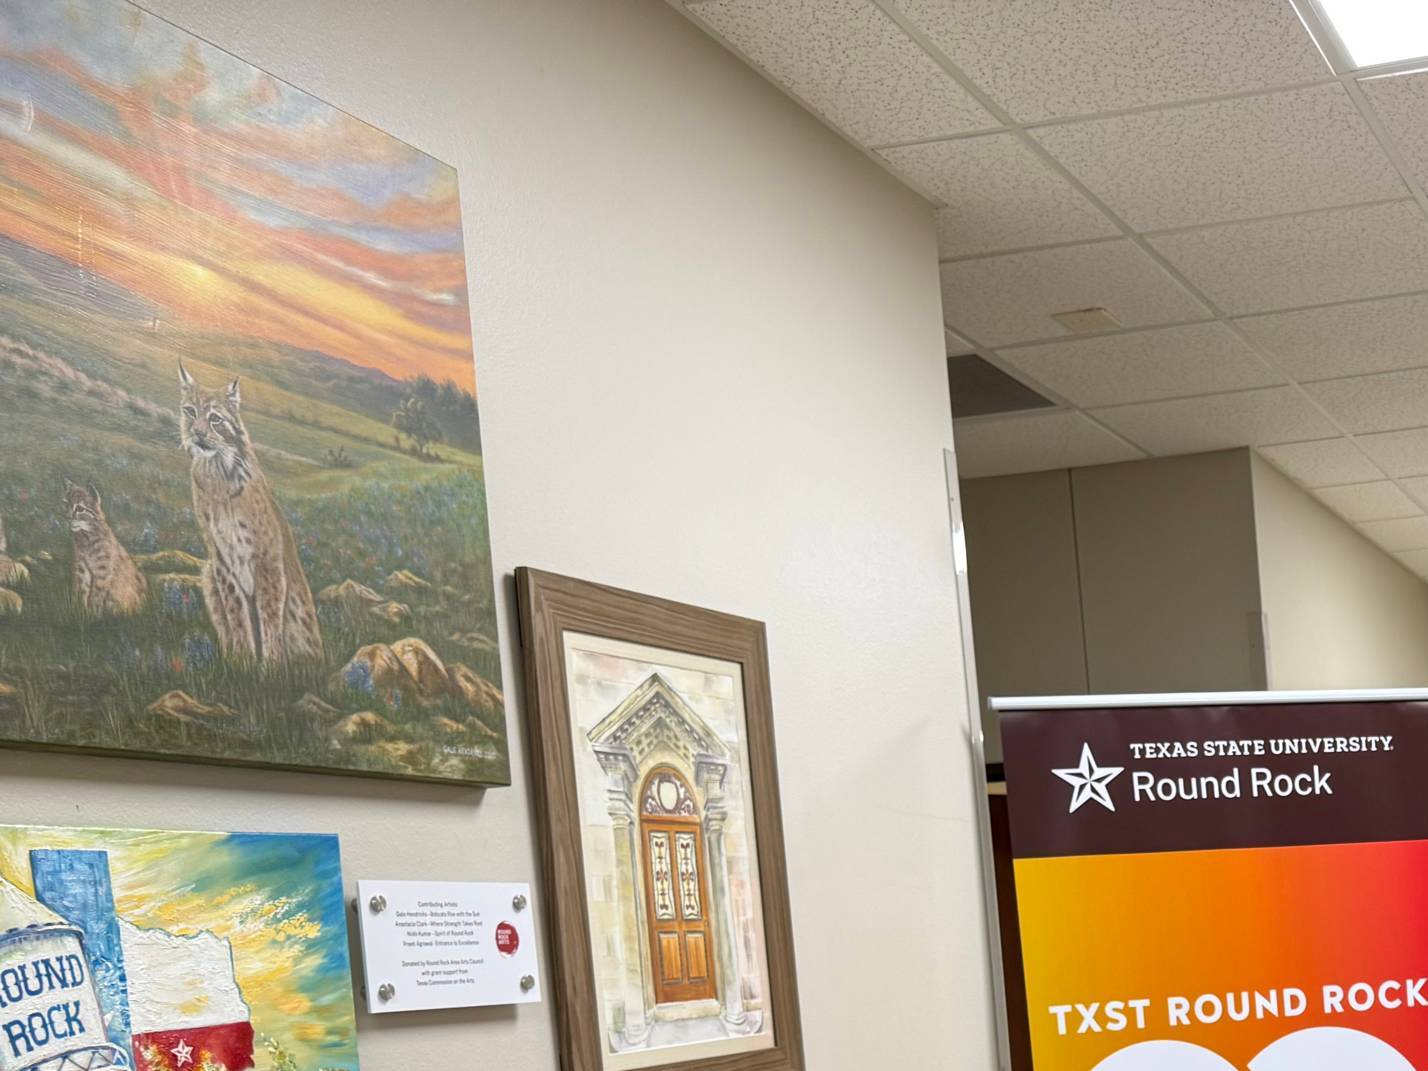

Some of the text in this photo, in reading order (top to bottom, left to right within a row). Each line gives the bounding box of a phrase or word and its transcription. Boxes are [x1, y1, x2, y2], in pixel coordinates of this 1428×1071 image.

[1130, 735, 1394, 759] TEXAS STATE UNIVERSITY
[1131, 765, 1333, 802] Round Rock
[0, 953, 85, 1008] OUND
[2, 1000, 86, 1058] ROCK
[1048, 999, 1151, 1036] TXST
[1167, 987, 1308, 1027] ROUND
